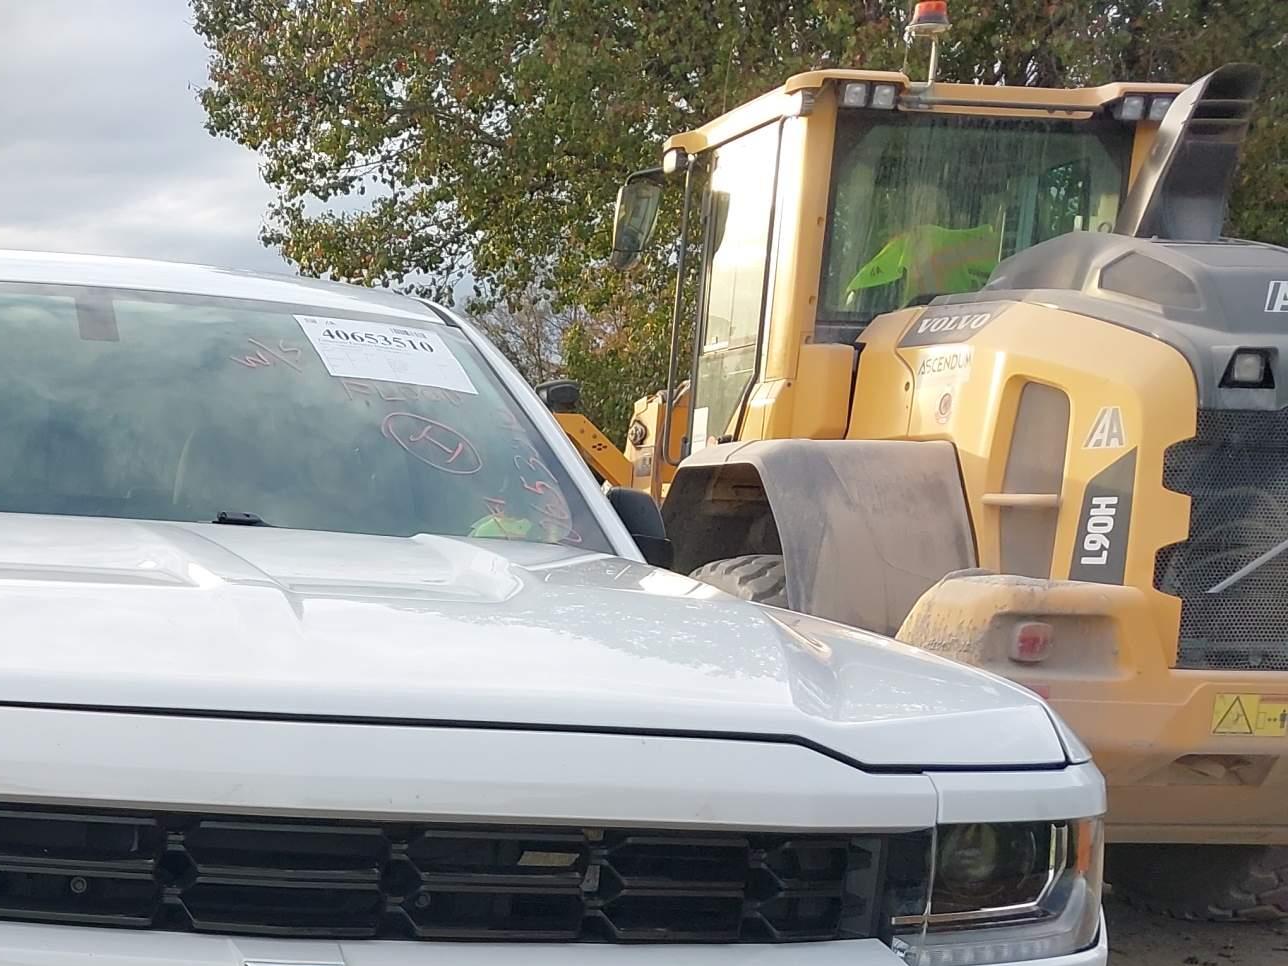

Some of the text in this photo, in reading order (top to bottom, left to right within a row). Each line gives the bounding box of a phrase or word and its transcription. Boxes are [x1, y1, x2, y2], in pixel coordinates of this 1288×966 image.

[918, 313, 991, 333] VOLVO
[322, 328, 434, 353] 40653510
[1080, 496, 1118, 565] L90H
